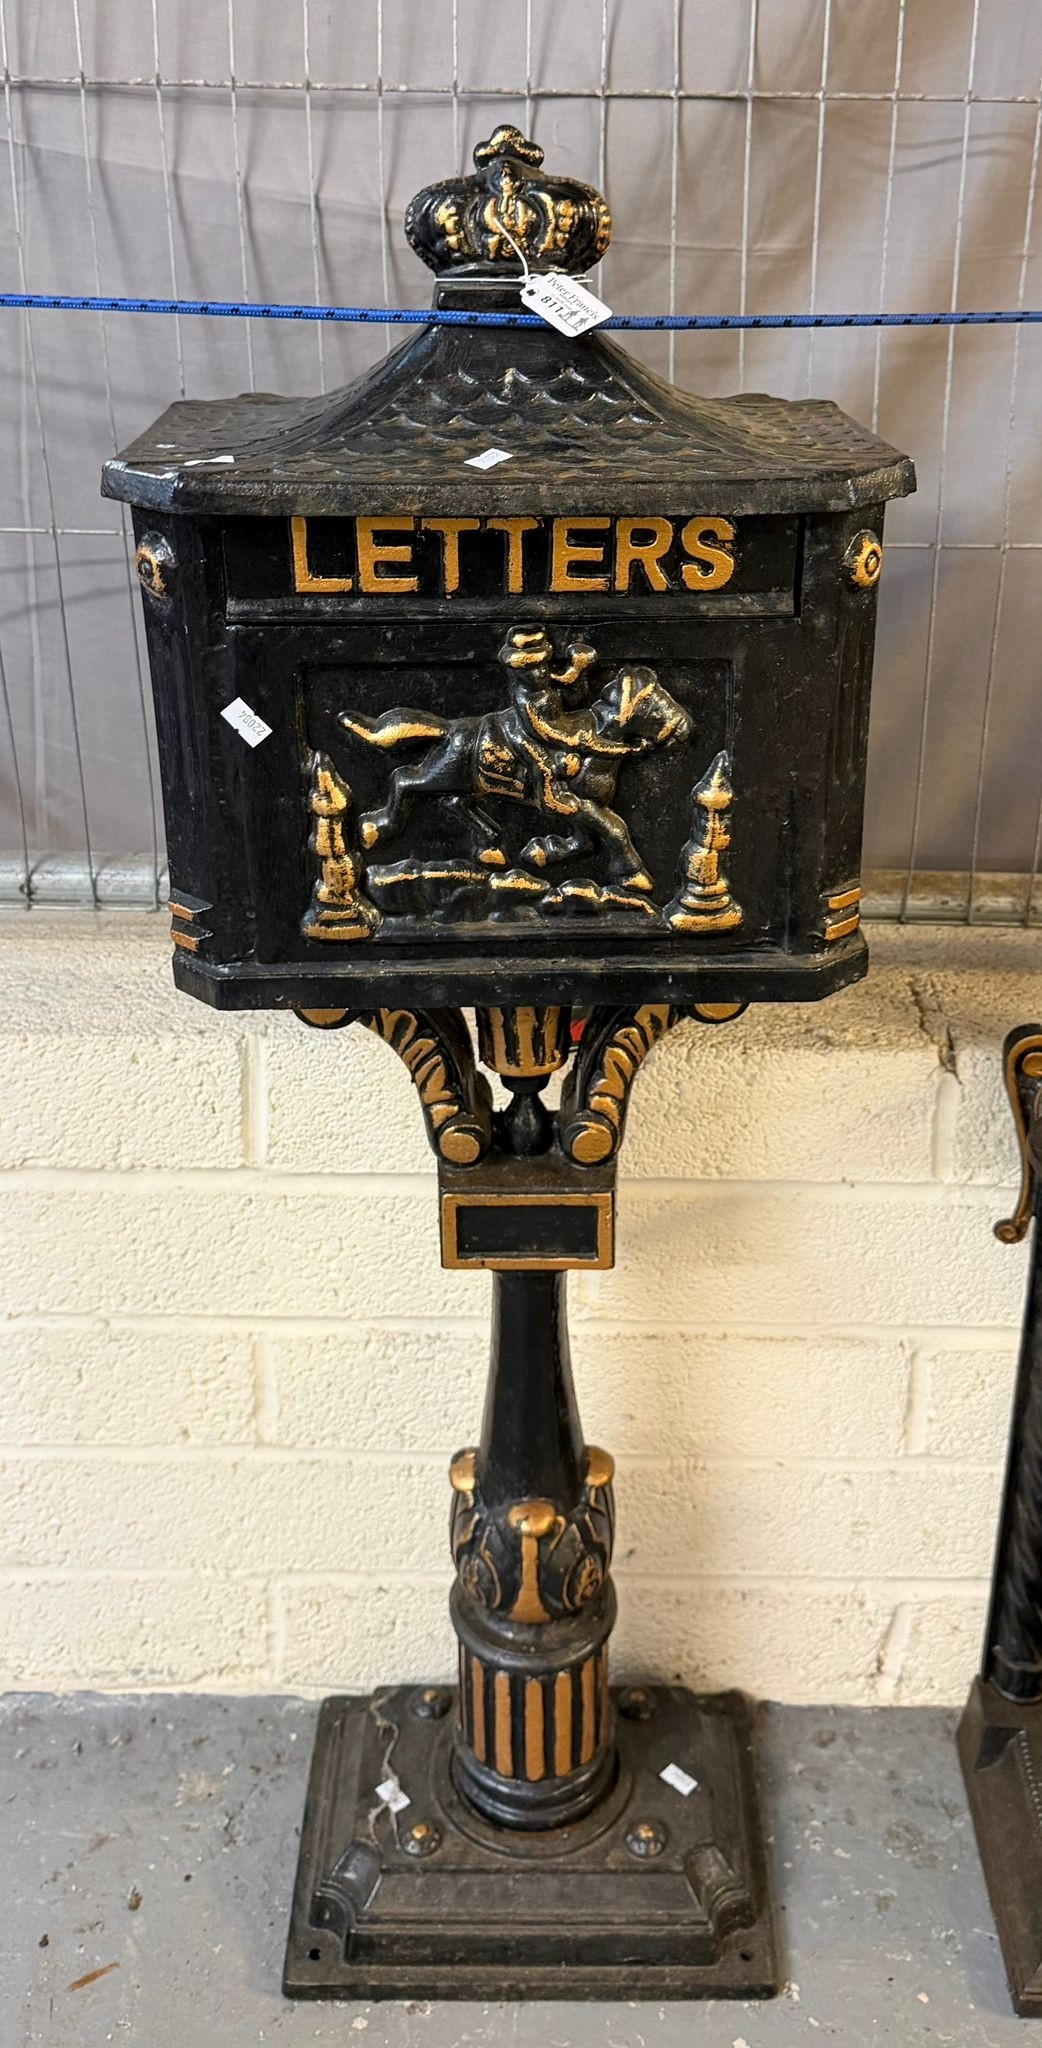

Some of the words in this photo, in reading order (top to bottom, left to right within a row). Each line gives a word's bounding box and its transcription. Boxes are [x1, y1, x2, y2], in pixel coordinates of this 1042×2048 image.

[540, 295, 564, 313] 811
[547, 277, 571, 296] Peter
[569, 293, 600, 320] Francis
[291, 516, 736, 594] LETTERS
[238, 710, 267, 737] 22084
